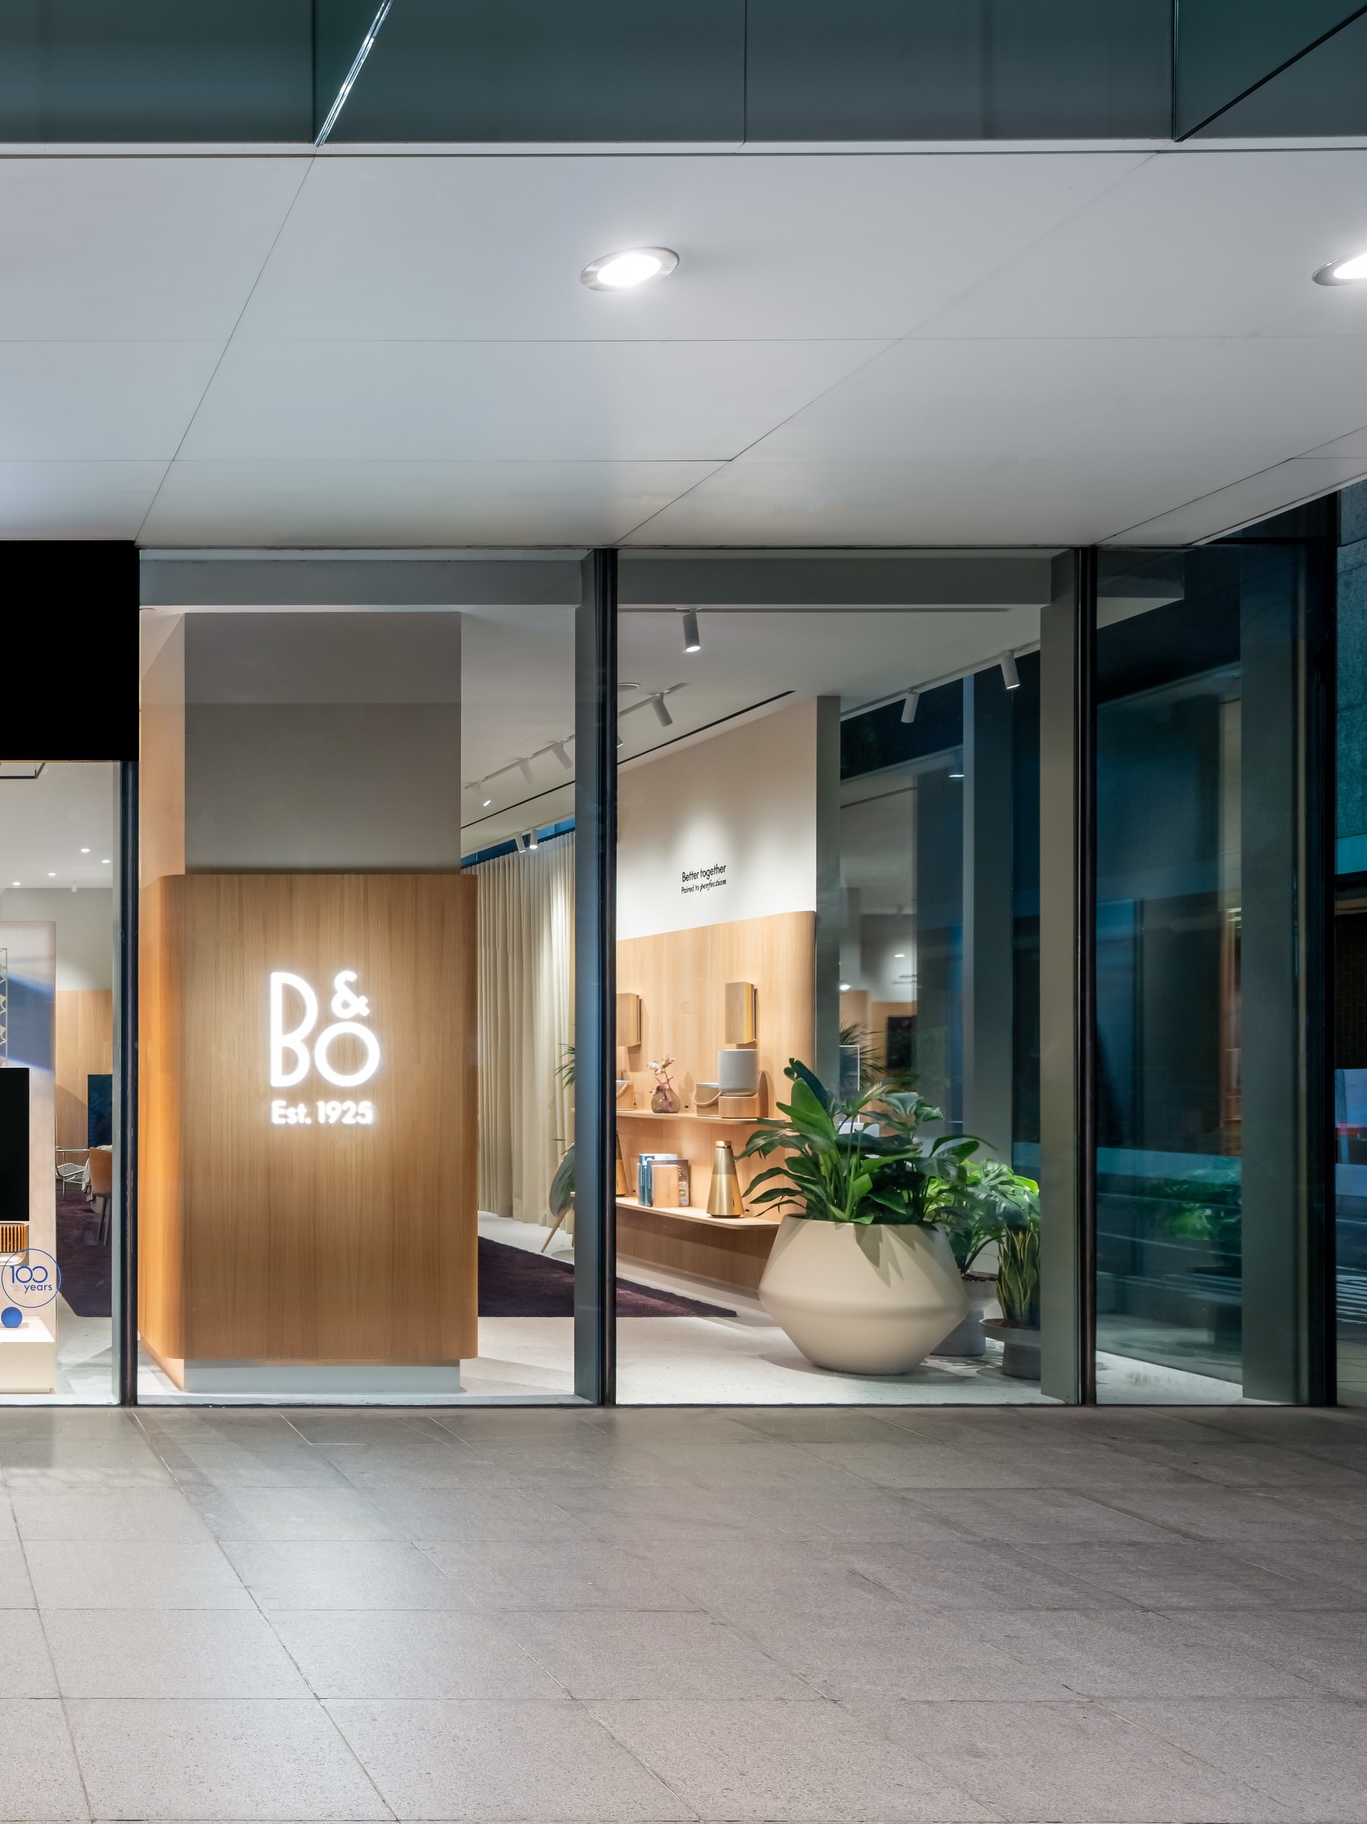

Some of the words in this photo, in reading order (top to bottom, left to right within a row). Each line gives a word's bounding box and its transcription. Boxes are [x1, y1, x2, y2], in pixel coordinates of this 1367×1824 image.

[681, 871, 699, 882] Better
[700, 863, 726, 880] together
[271, 1100, 312, 1124] Est.
[316, 1100, 374, 1124] 1925
[10, 1265, 48, 1283] 100
[24, 1284, 53, 1294] years
